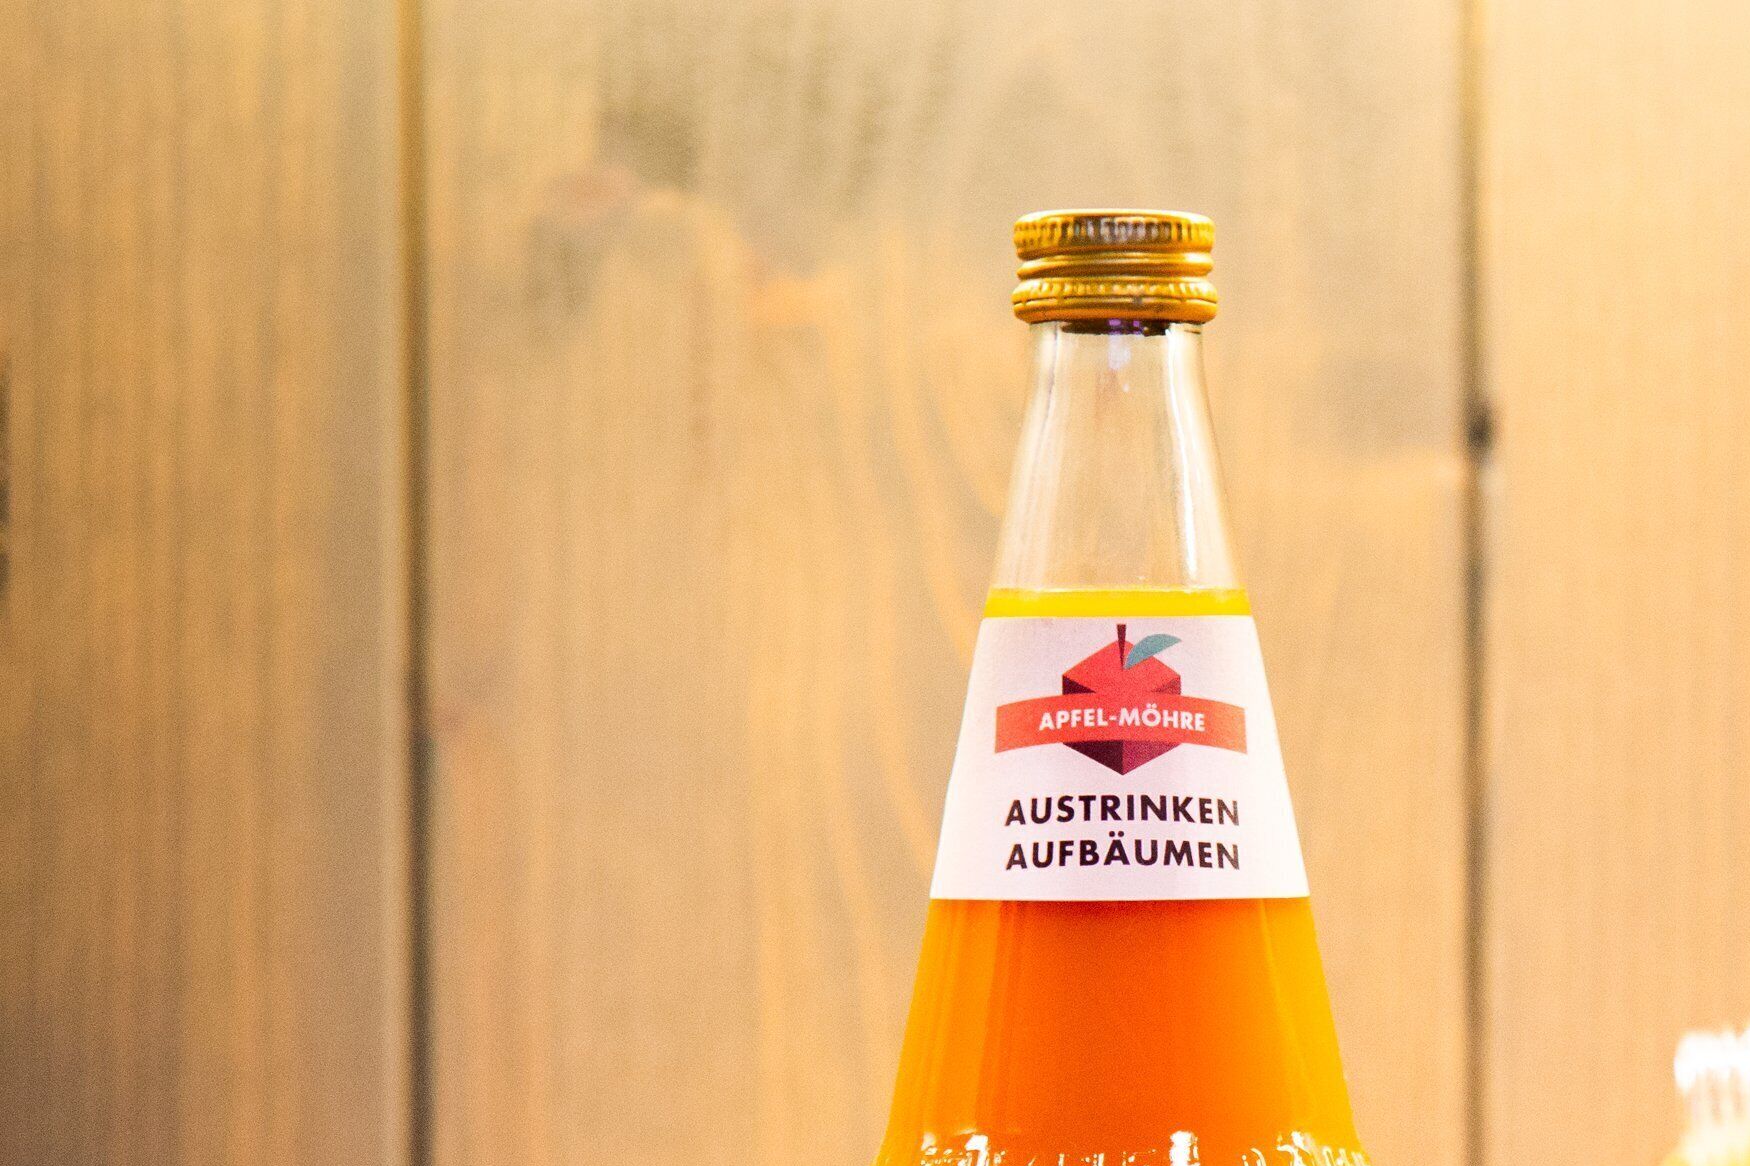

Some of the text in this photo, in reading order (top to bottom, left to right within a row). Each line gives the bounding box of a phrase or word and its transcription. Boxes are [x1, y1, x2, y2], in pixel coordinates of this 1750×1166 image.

[1038, 702, 1206, 732] APFEL-MÖHRE
[1004, 794, 1240, 827] AUSTRINKEN
[1005, 830, 1241, 870] AUFBÄUMEN
